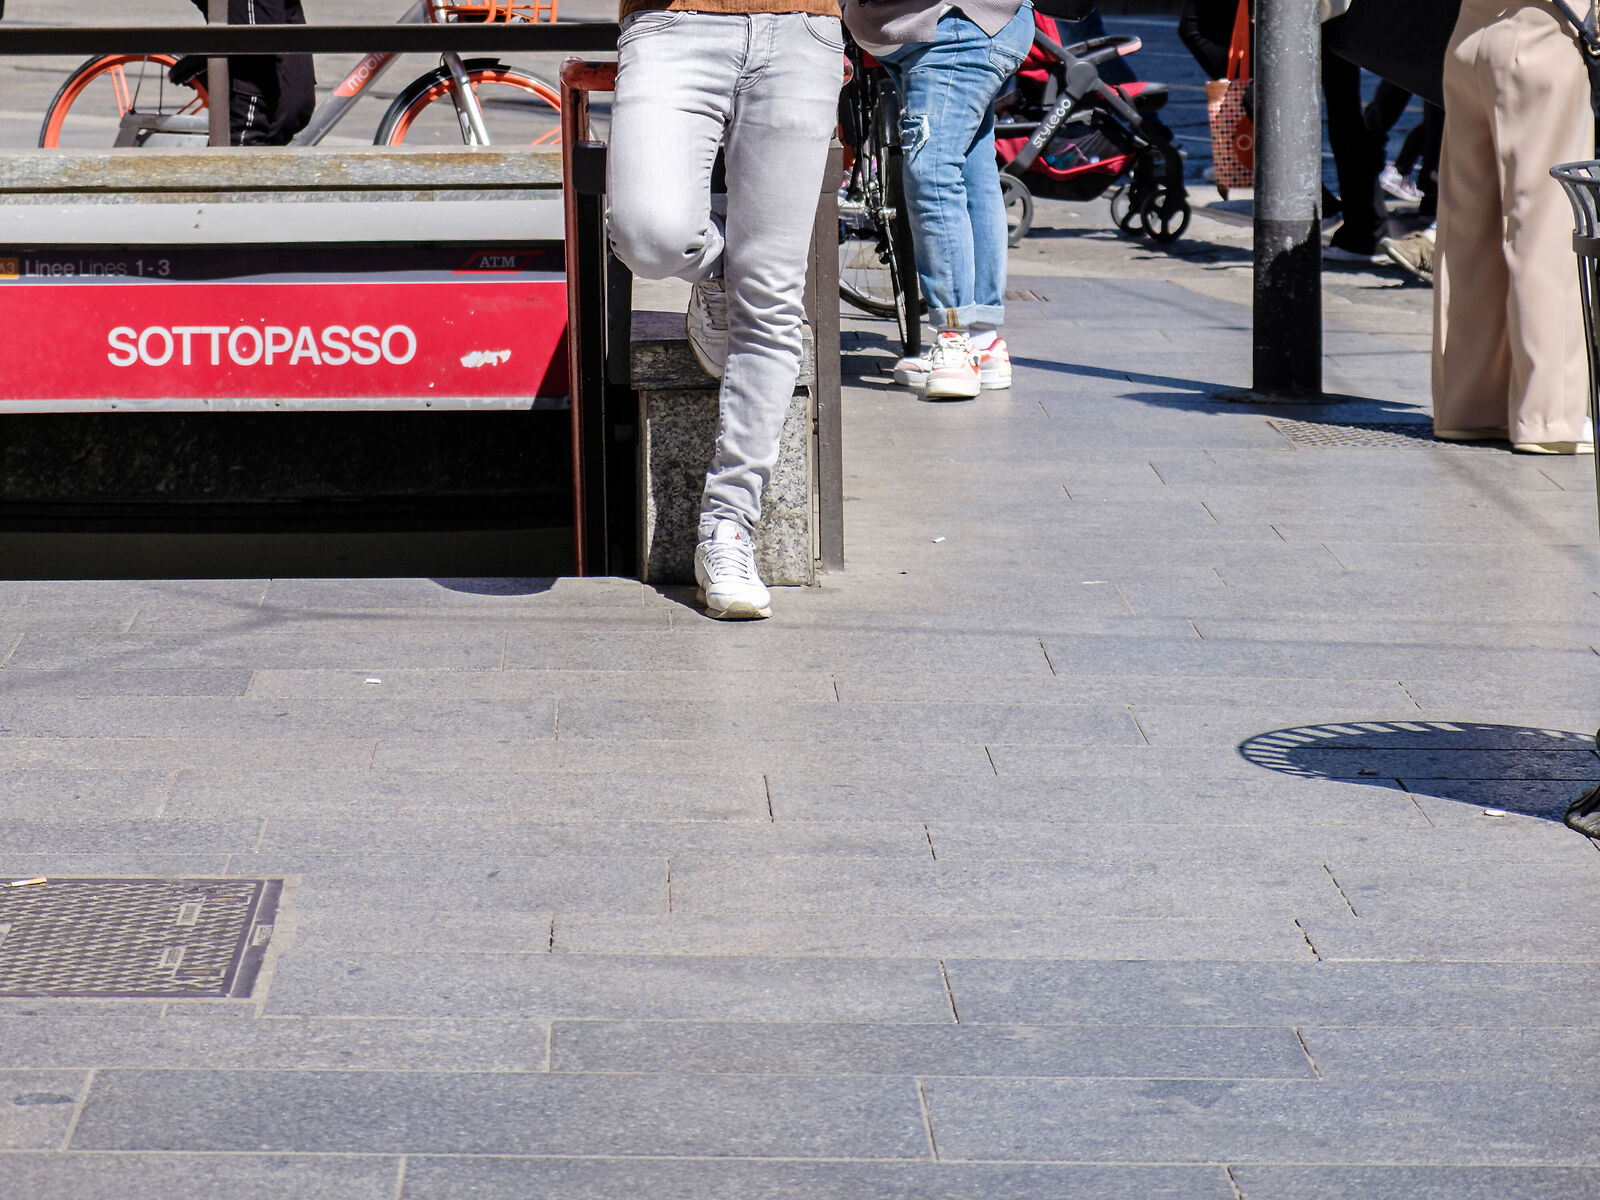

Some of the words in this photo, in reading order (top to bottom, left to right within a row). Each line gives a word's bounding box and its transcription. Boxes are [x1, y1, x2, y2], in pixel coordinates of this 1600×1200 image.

[25, 259, 75, 277] Linee
[79, 259, 127, 277] Lines
[479, 256, 516, 268] ATM
[107, 325, 417, 367] SOTTOPASSO
